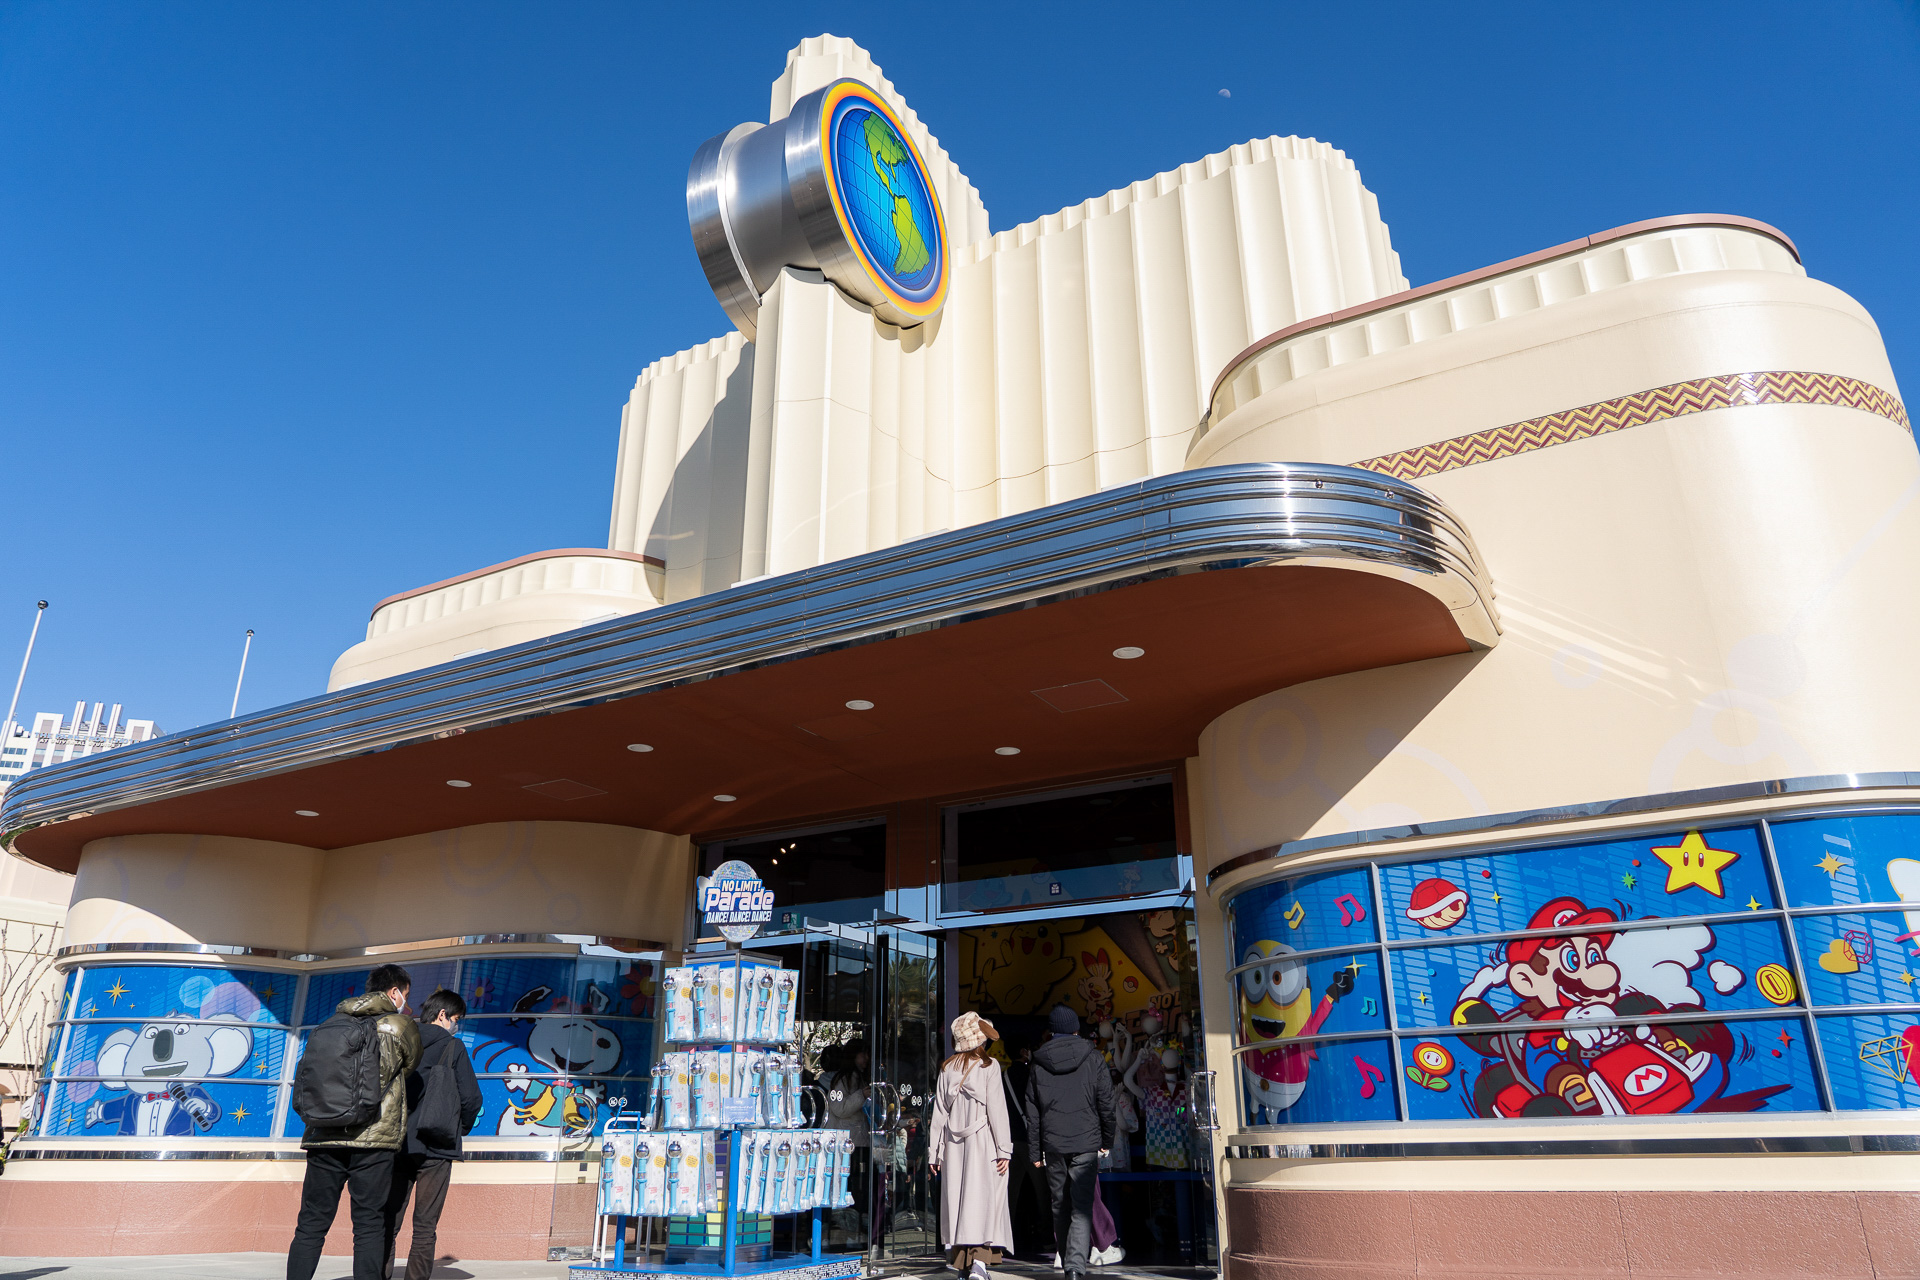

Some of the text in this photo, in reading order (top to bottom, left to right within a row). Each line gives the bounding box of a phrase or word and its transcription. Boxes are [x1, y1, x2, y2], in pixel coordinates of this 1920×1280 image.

[722, 880, 762, 892] NO LIMIT!
[705, 888, 774, 911] Parade
[705, 910, 772, 924] DANCE! DANCE! DANCE!
